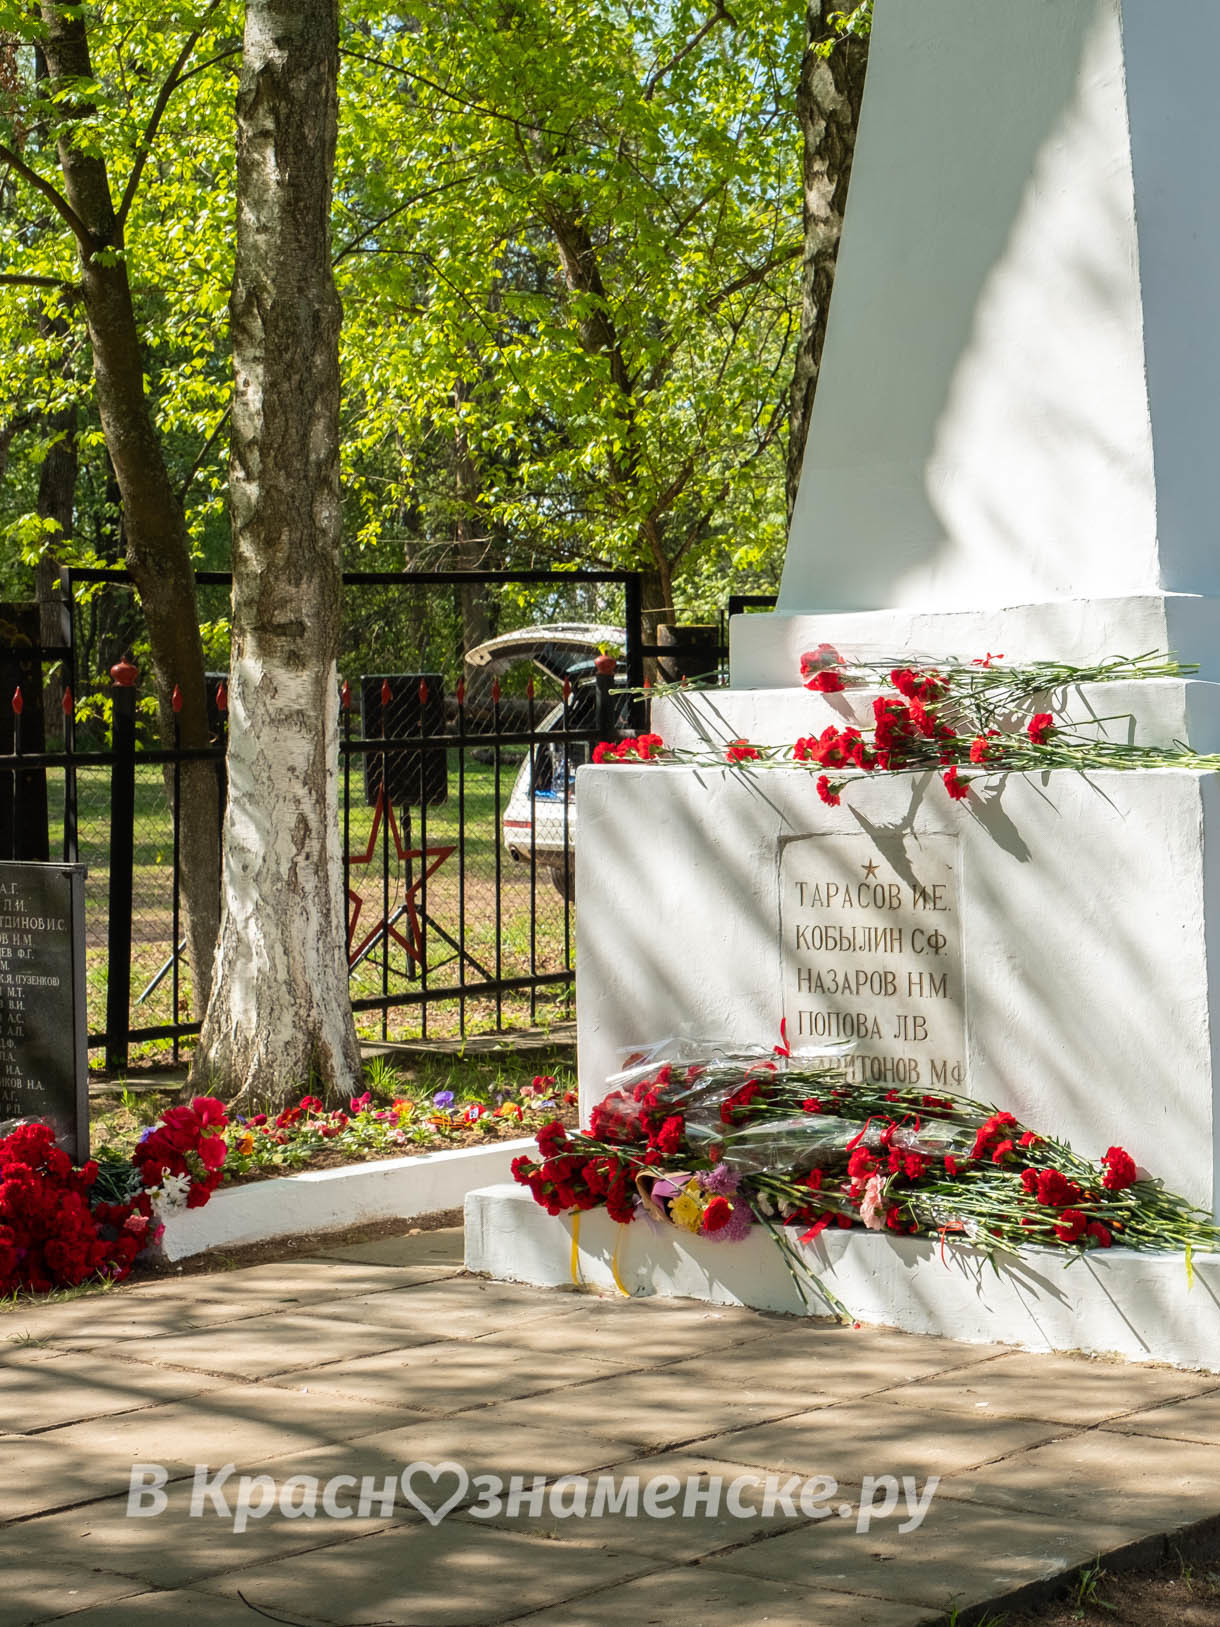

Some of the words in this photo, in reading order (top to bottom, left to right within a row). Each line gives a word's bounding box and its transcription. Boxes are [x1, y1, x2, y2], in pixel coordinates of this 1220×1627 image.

[794, 881, 902, 910] ТАРАСОВ
[911, 883, 952, 911] И.Е.
[795, 924, 903, 954] КОБЫЛИН
[796, 967, 898, 997] НАЗАРОВ
[797, 1010, 883, 1041] ПОПОВА
